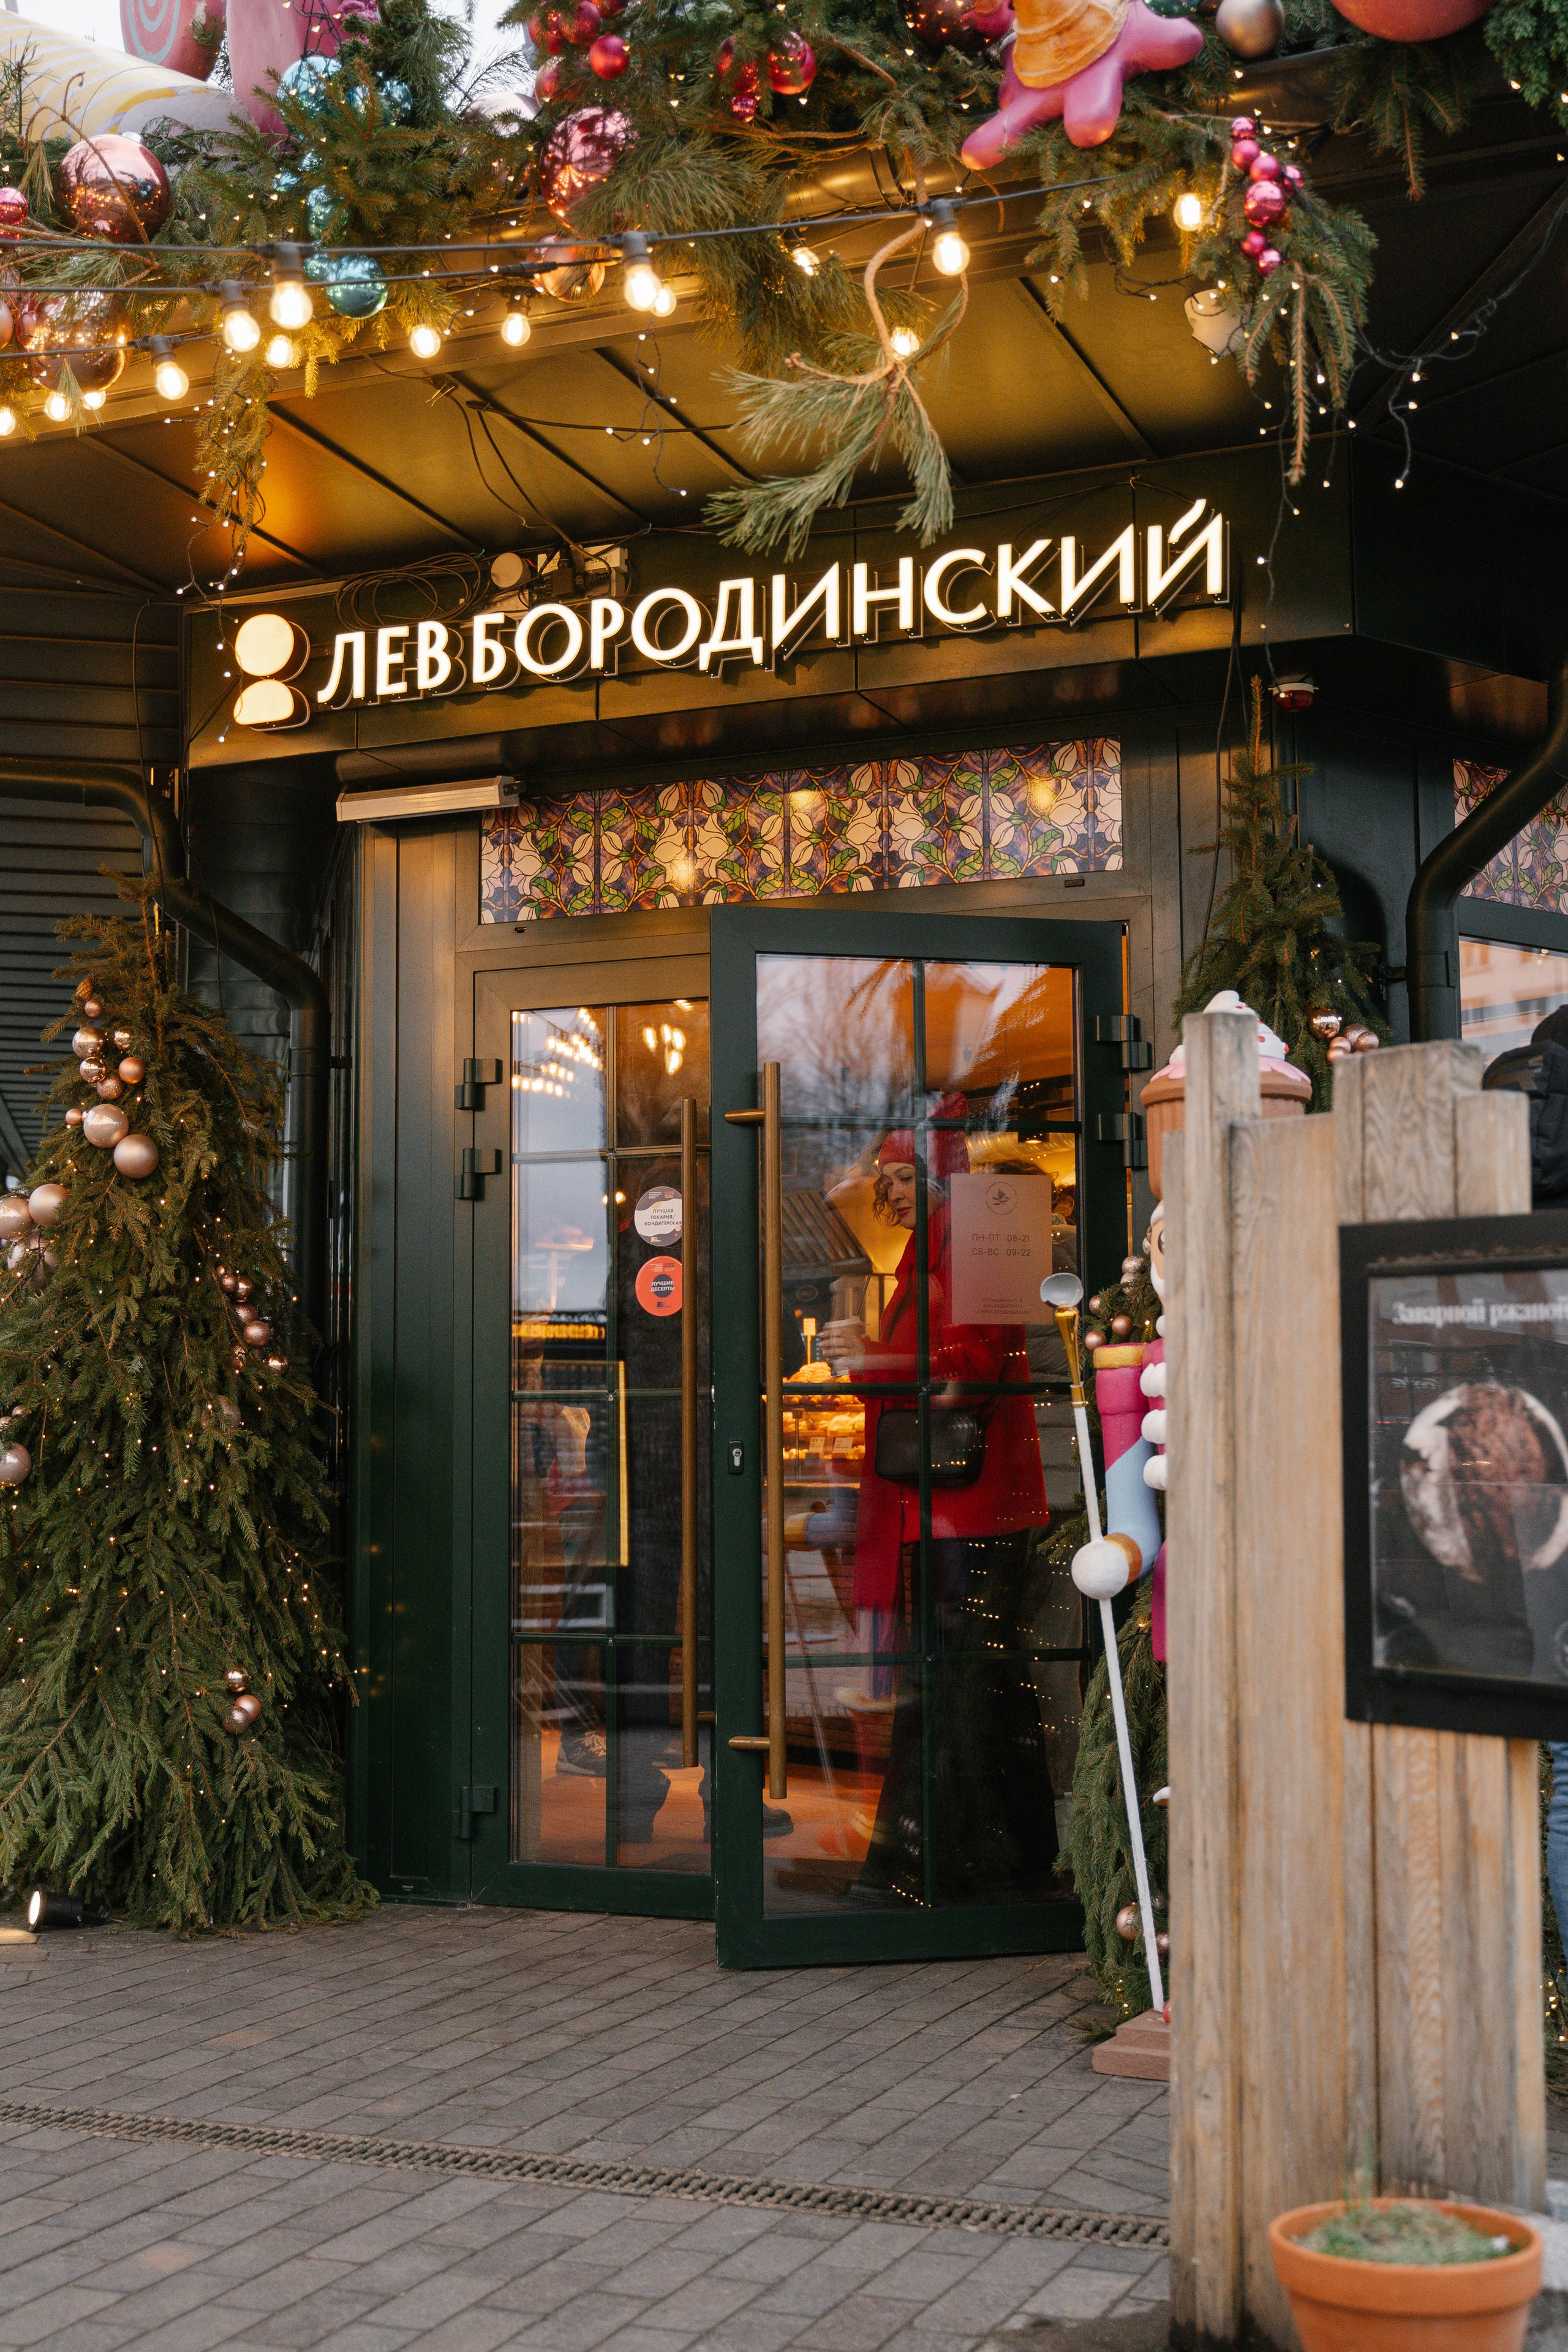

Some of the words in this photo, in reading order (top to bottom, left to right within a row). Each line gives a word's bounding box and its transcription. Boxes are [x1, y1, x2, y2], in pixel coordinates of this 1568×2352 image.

[317, 620, 451, 704] ЛЕВ
[472, 497, 1224, 685] БОРОДИНСКИЙ
[1392, 1297, 1486, 1329] Заварной
